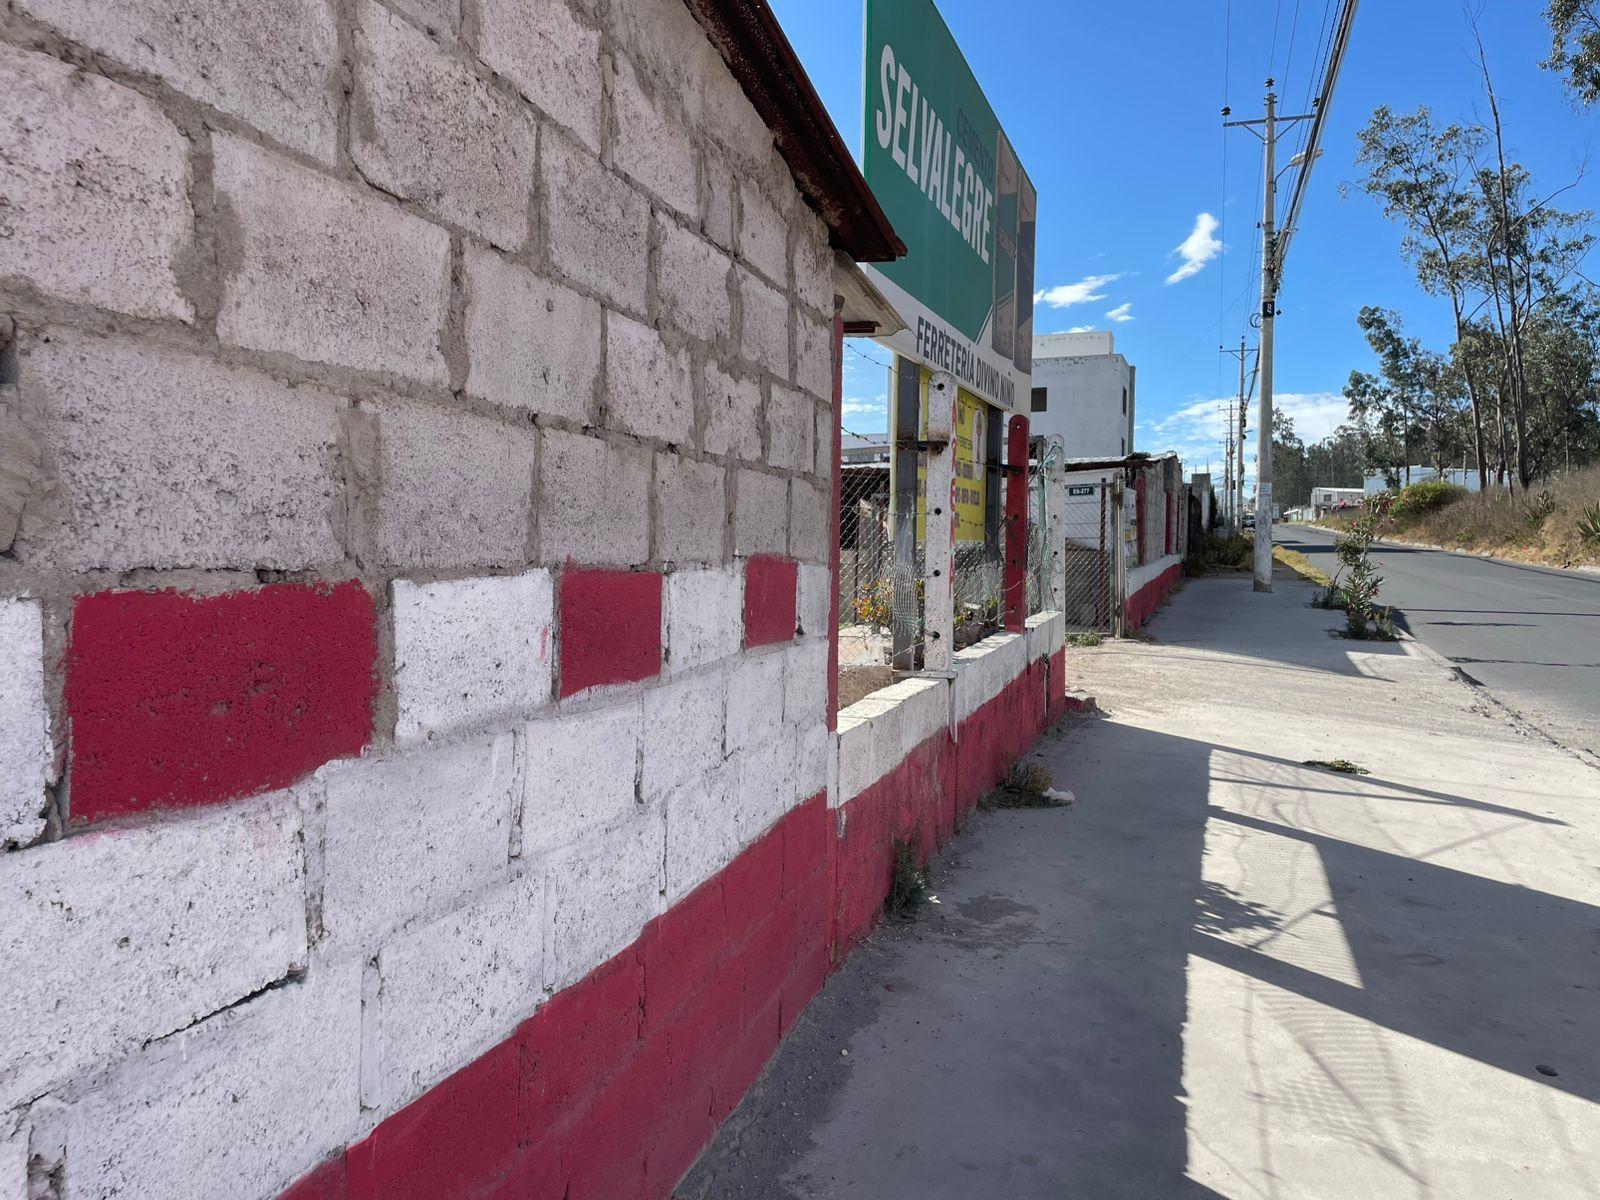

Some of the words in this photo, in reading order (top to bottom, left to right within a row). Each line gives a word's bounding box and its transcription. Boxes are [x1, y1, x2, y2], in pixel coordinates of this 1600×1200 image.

[876, 43, 993, 265] SELVALEGRE
[957, 107, 993, 182] CEMENTO
[976, 356, 999, 399] DIVINO
